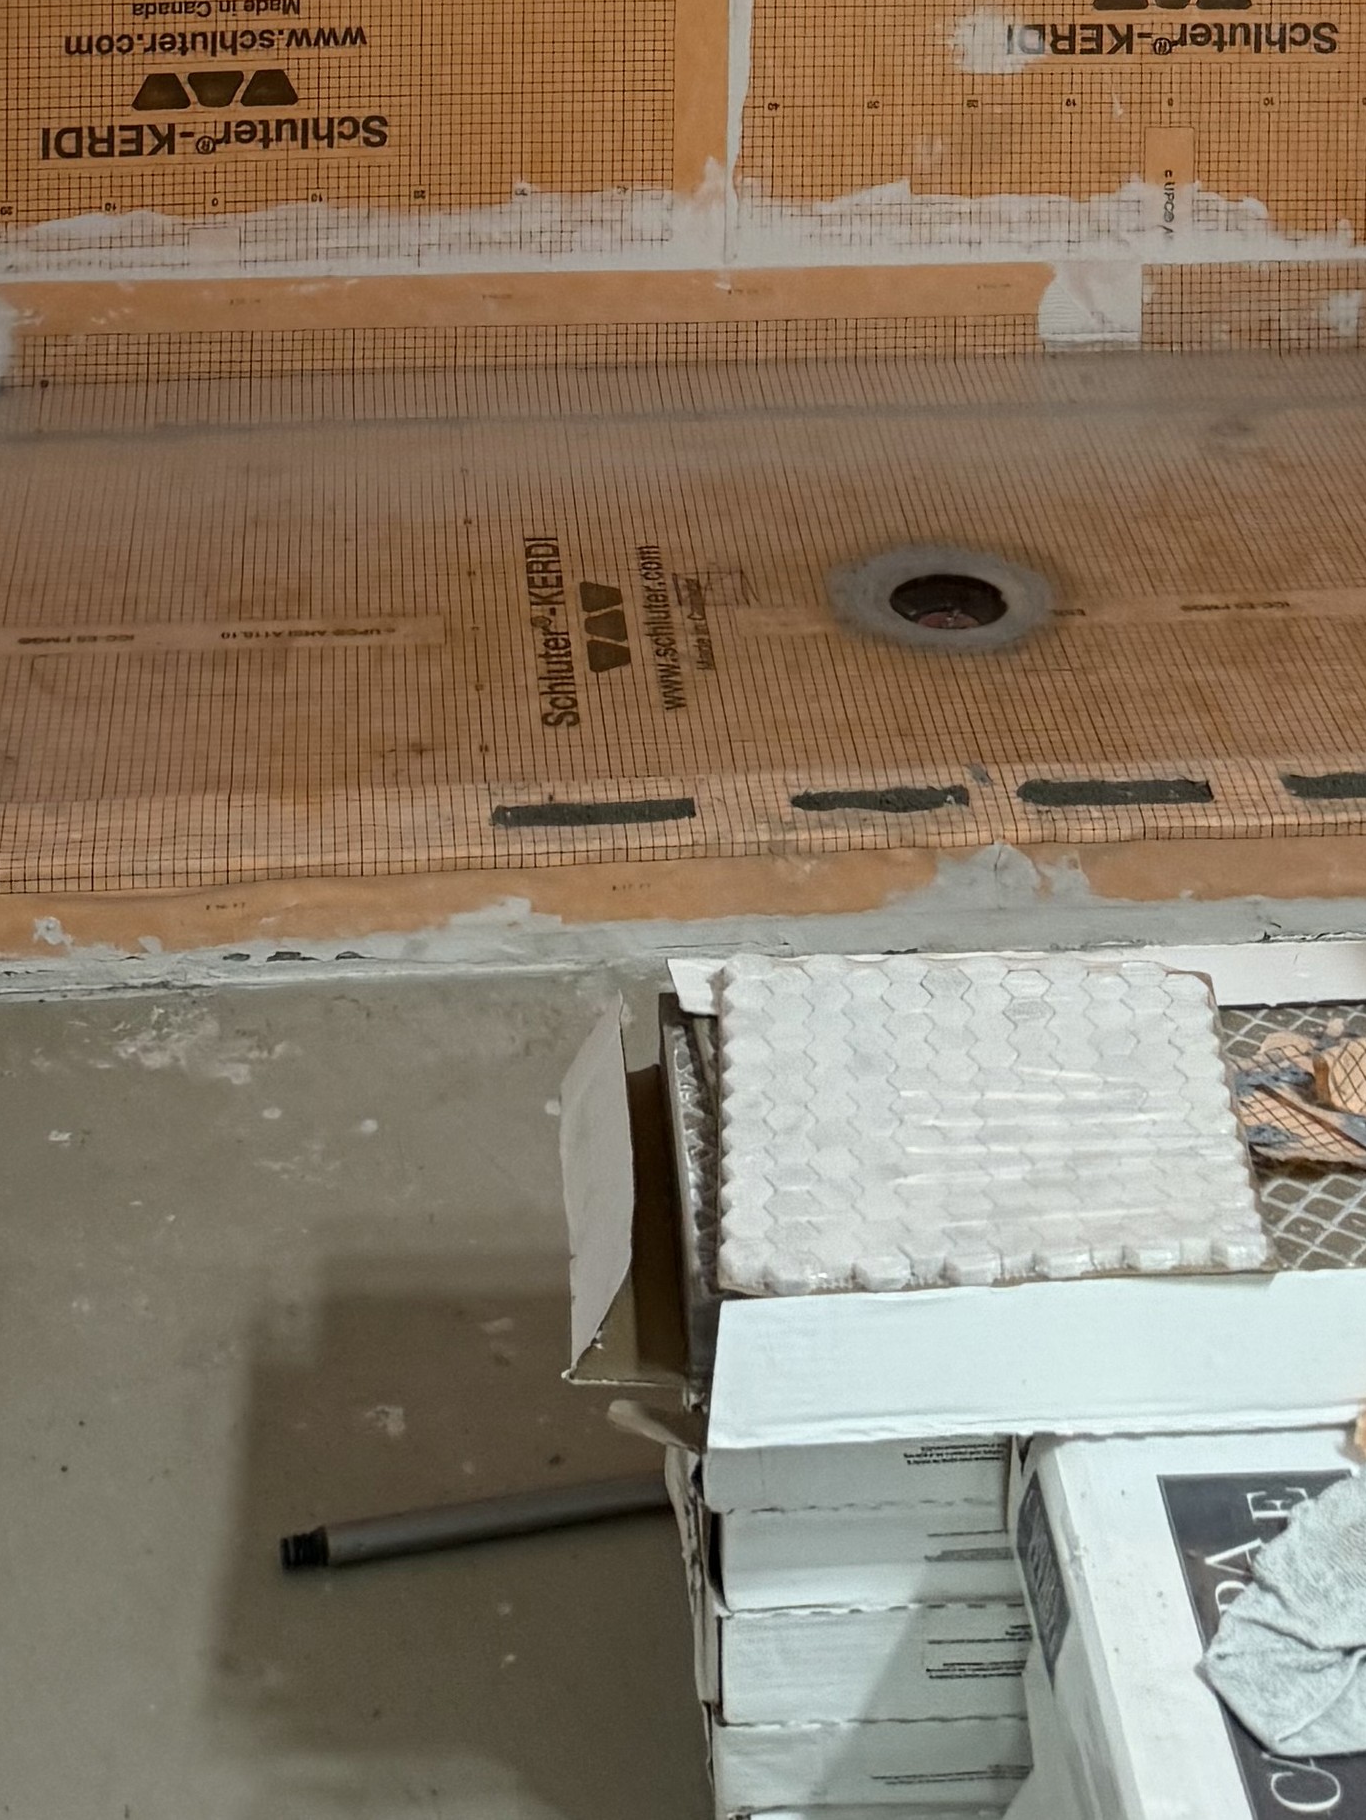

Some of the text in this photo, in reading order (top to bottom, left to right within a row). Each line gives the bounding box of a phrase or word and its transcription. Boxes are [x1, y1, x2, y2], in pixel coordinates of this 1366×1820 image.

[131, 0, 212, 19] Canada
[219, 0, 237, 17] in
[65, 26, 366, 58] www.schluter.com
[635, 545, 687, 710] www.schluter.com
